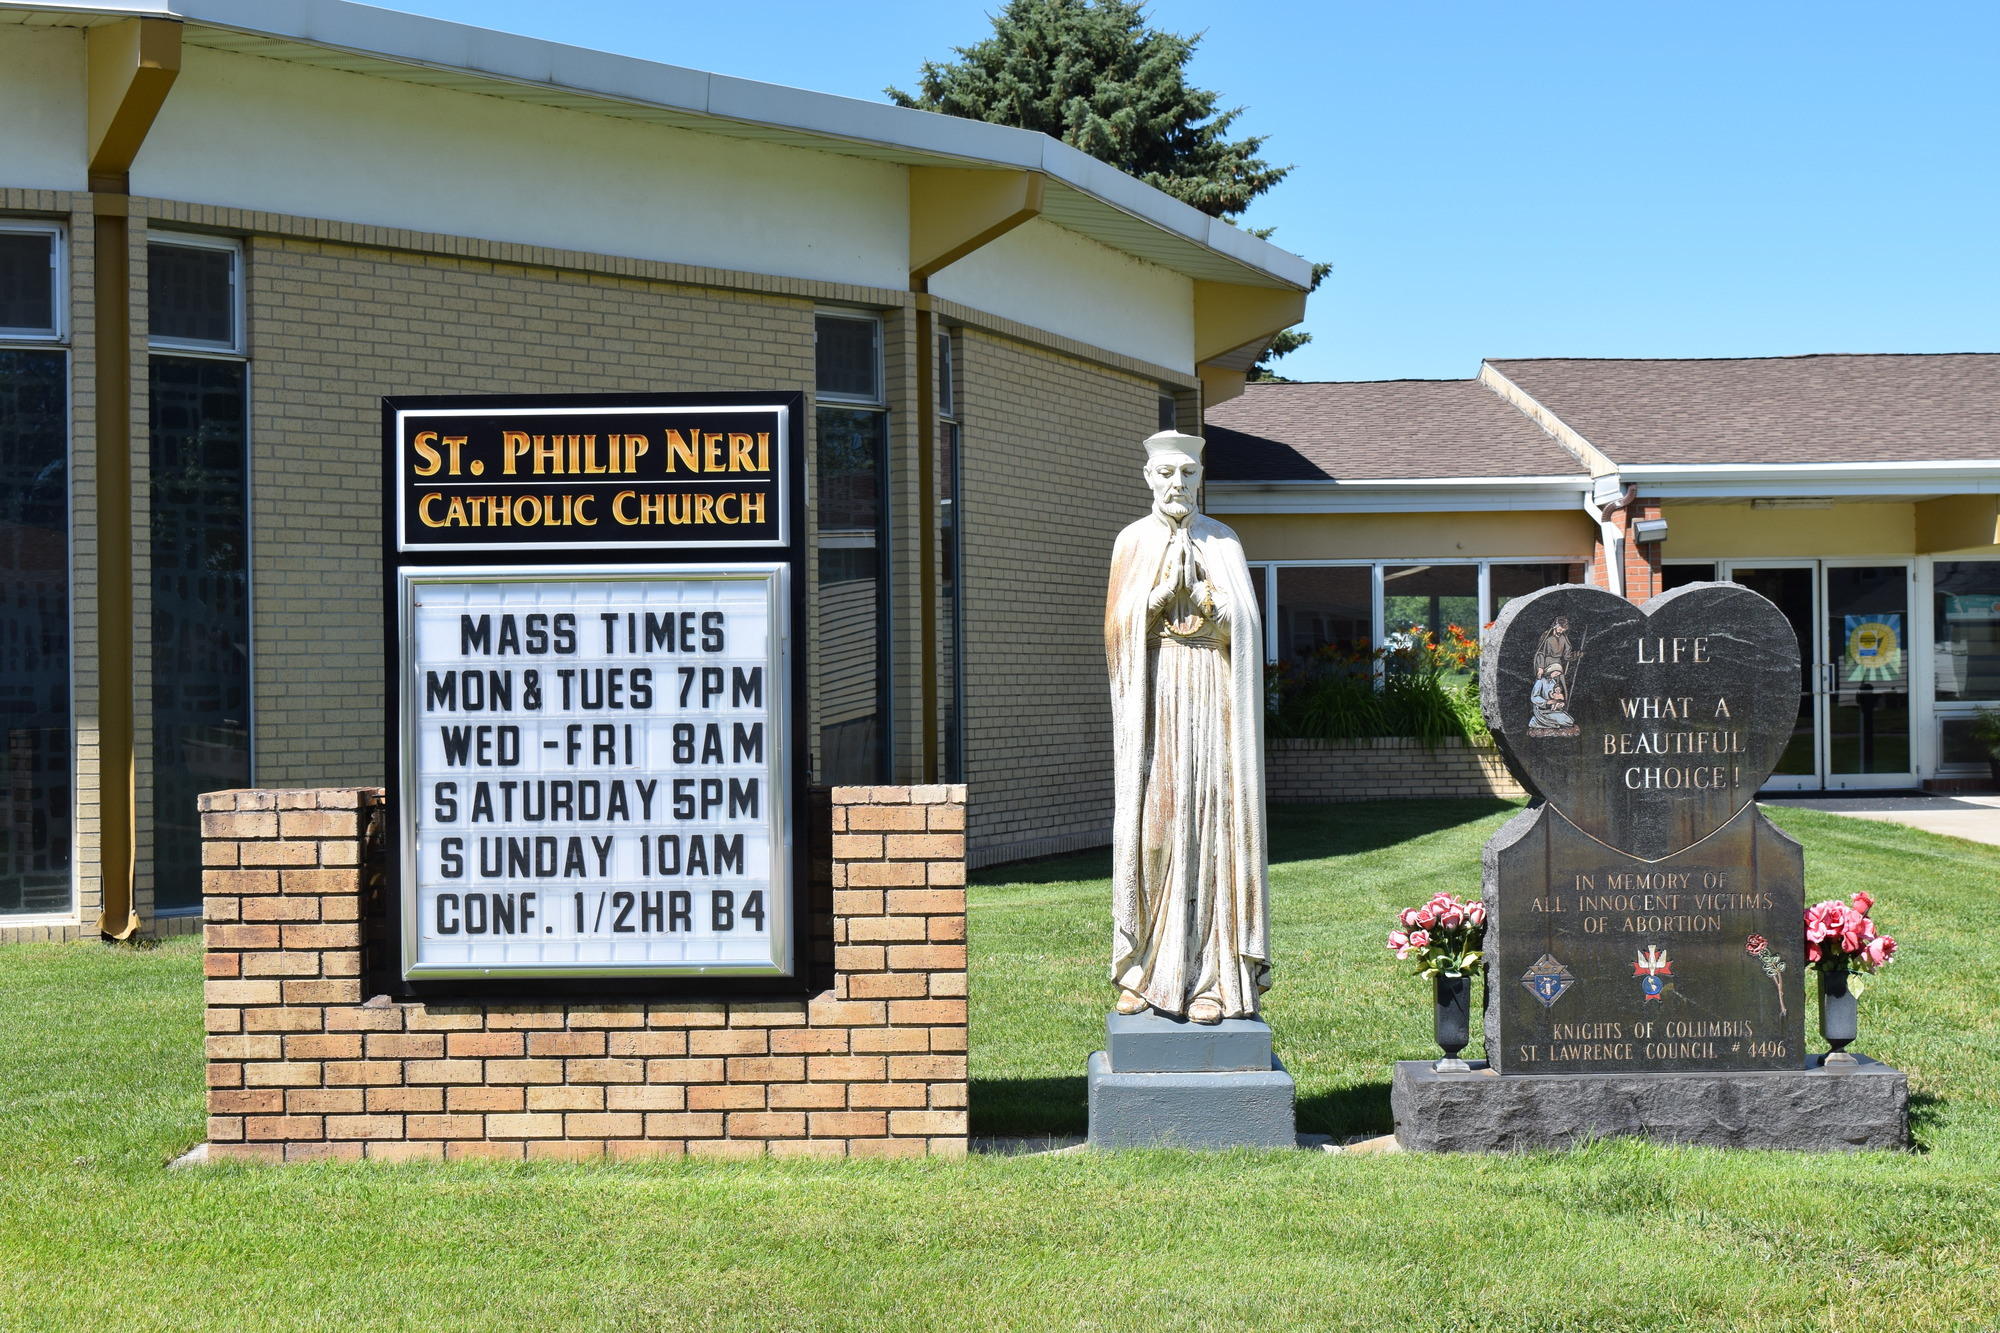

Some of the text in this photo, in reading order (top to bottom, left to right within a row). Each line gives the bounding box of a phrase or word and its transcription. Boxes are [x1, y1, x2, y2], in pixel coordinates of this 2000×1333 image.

[419, 490, 766, 527] CATHOLIC CHURCH
[461, 611, 724, 655] MASS TIMES
[1637, 637, 1710, 663] LIFE
[678, 666, 762, 708] 7PM
[1620, 697, 1730, 719] WHAT A
[441, 724, 520, 766] WED
[672, 722, 762, 765] 8AM
[1604, 732, 1746, 755] BEAUTIFUL
[435, 779, 758, 823] SATURDAY 5PM
[441, 834, 744, 878] SUNDAY 10AM
[1576, 873, 1727, 890] IN MEMORY OF
[437, 890, 764, 935] CONF. 1/2HR B4
[1531, 893, 1774, 912] ALL INNOCENT VICTIMS
[1584, 915, 1721, 933] OF ABORTION
[1553, 1020, 1753, 1040] KNIGHTS OF COLUMBUS
[1521, 1045, 1540, 1062] ST.
[1551, 1043, 1633, 1061] LAWRENCE
[1646, 1042, 1717, 1059] COUNCIL
[1748, 1041, 1786, 1058] 4496
